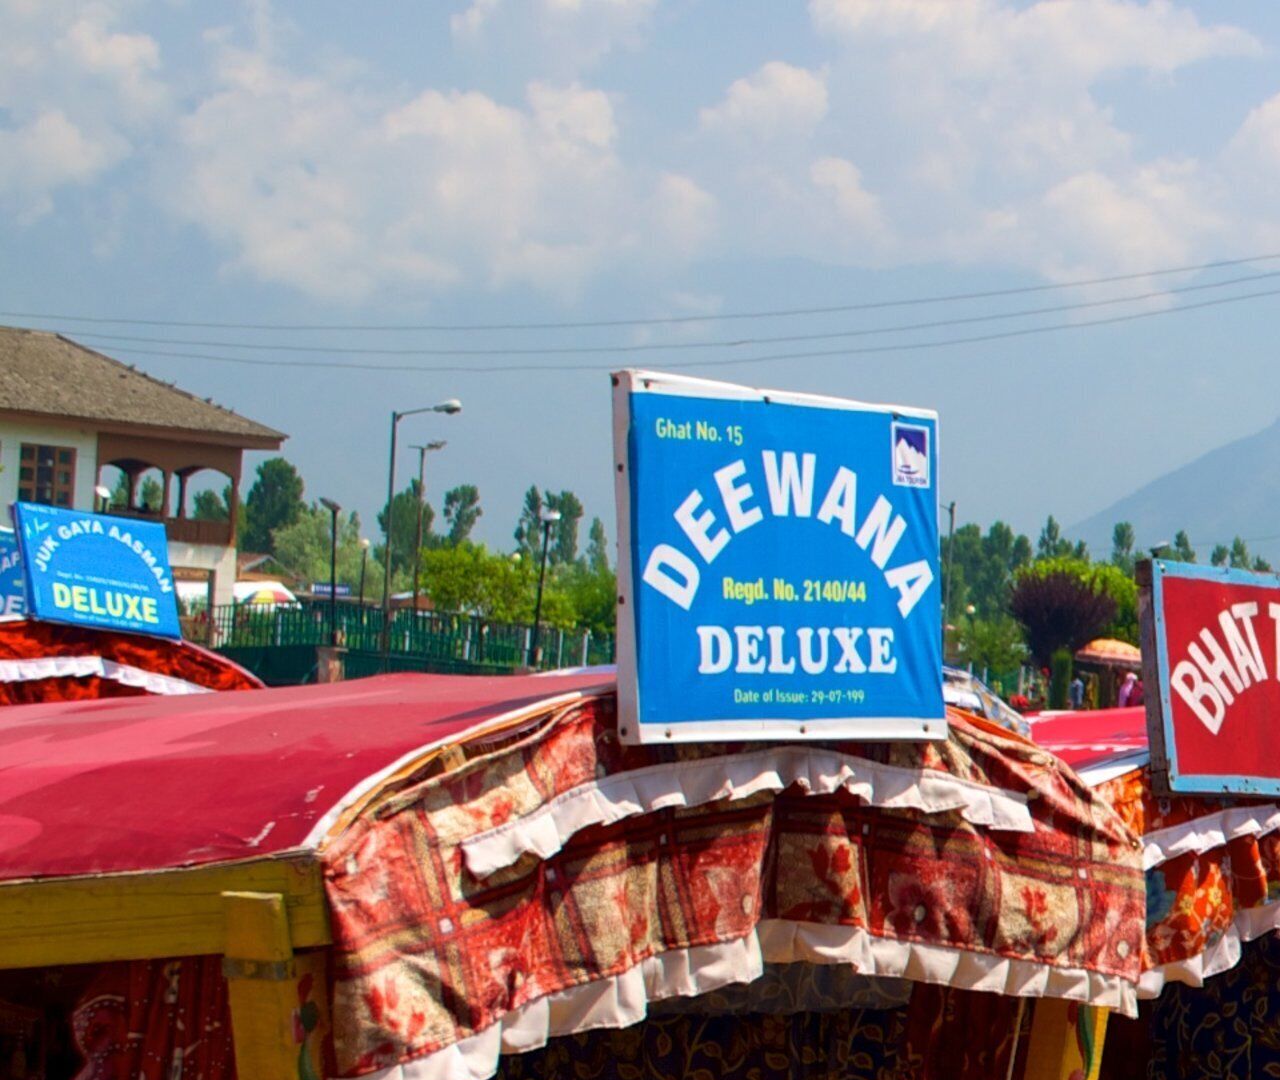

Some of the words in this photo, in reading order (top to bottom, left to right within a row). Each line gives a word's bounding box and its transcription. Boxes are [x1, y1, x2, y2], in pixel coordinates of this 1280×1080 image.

[656, 418, 692, 440] Ghat
[696, 421, 722, 442] No.
[726, 426, 743, 446] 15
[34, 535, 60, 572] JUK
[57, 519, 104, 540] GAYA
[109, 526, 173, 593] AASMAN
[642, 450, 934, 619] DEEWANA
[53, 583, 159, 624] DELUXE
[723, 577, 769, 605] Regd.
[773, 578, 799, 601] No.
[803, 580, 867, 603] 2140/44
[696, 625, 897, 675] DELUXE
[1171, 602, 1268, 736] BHAT
[734, 688, 759, 704] Date
[763, 688, 775, 704] of
[776, 688, 809, 704] Issue:
